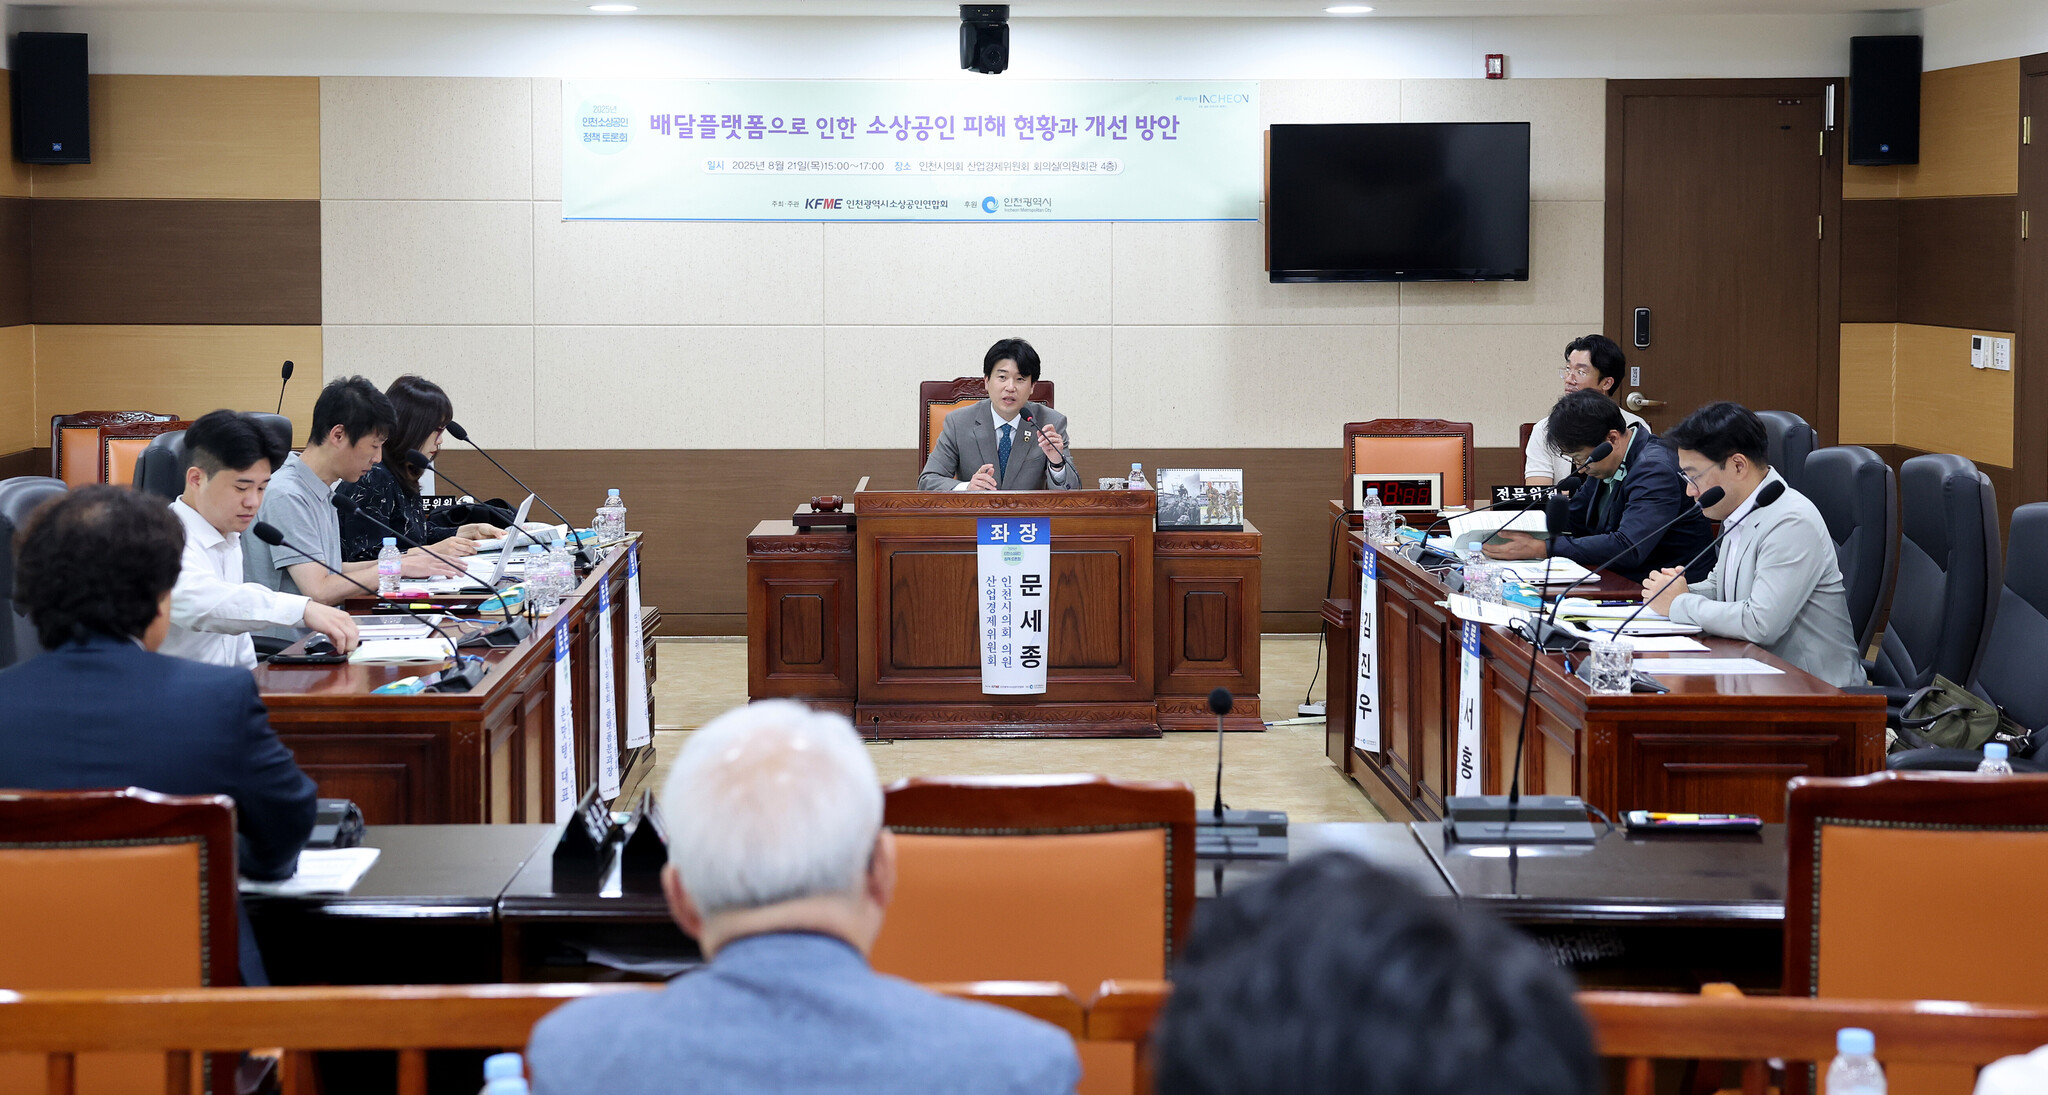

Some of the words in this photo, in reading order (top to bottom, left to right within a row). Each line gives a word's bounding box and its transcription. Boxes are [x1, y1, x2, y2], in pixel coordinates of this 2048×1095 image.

[1199, 94, 1249, 104] INCHEON
[593, 105, 617, 114] 2025년
[583, 132, 600, 142] 정책
[602, 132, 628, 142] 토론회
[650, 114, 809, 140] 배달플랫폼으로
[816, 116, 857, 140] 인한
[866, 115, 955, 141] 소상공인
[963, 115, 1006, 137] 피해
[1014, 115, 1078, 141] 현황과
[1085, 115, 1128, 140] 개선
[1136, 115, 1180, 141] 방안
[707, 160, 724, 170] 일시
[732, 160, 765, 170] 2025년
[768, 160, 784, 170] 8월
[894, 160, 912, 172] 장소
[918, 161, 964, 172] 인천시의회
[966, 161, 1030, 172] 산업경제위원회
[1033, 161, 1098, 172] 회의실(의원회관
[1100, 161, 1118, 172] 4층)
[804, 198, 843, 210] KFME
[846, 199, 948, 210] 인천광역시소상공인연합회
[964, 200, 978, 208] 후원
[1003, 197, 1052, 207] 인천광역시
[422, 498, 453, 510] 문위원
[1001, 576, 1012, 639] 인천시의회
[986, 575, 997, 667] 산업경제위원회
[1020, 574, 1042, 668] 문세종
[1002, 642, 1012, 668] 의원
[1358, 612, 1372, 720] 김진우
